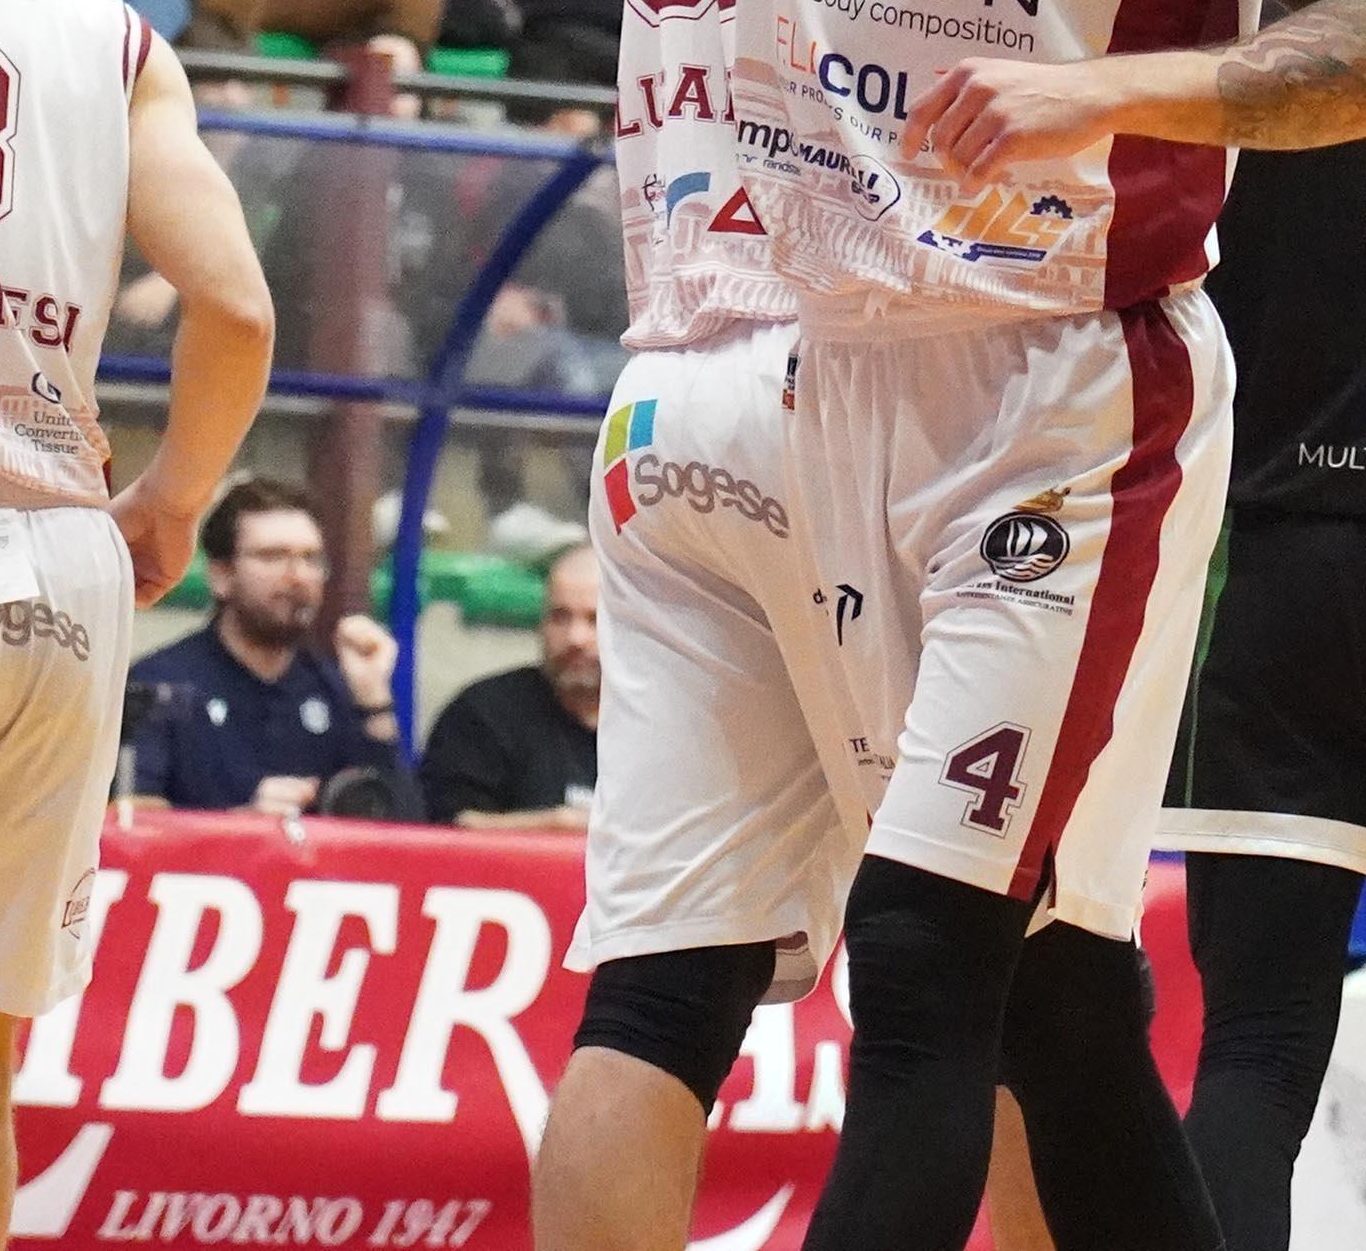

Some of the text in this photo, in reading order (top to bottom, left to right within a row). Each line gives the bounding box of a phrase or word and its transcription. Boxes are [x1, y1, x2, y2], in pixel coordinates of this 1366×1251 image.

[870, 1, 1035, 53] composition
[633, 453, 790, 539] Sogese
[995, 580, 1076, 606] International
[938, 721, 1032, 839] 4
[97, 1190, 493, 1249] LIVORNO 1947
